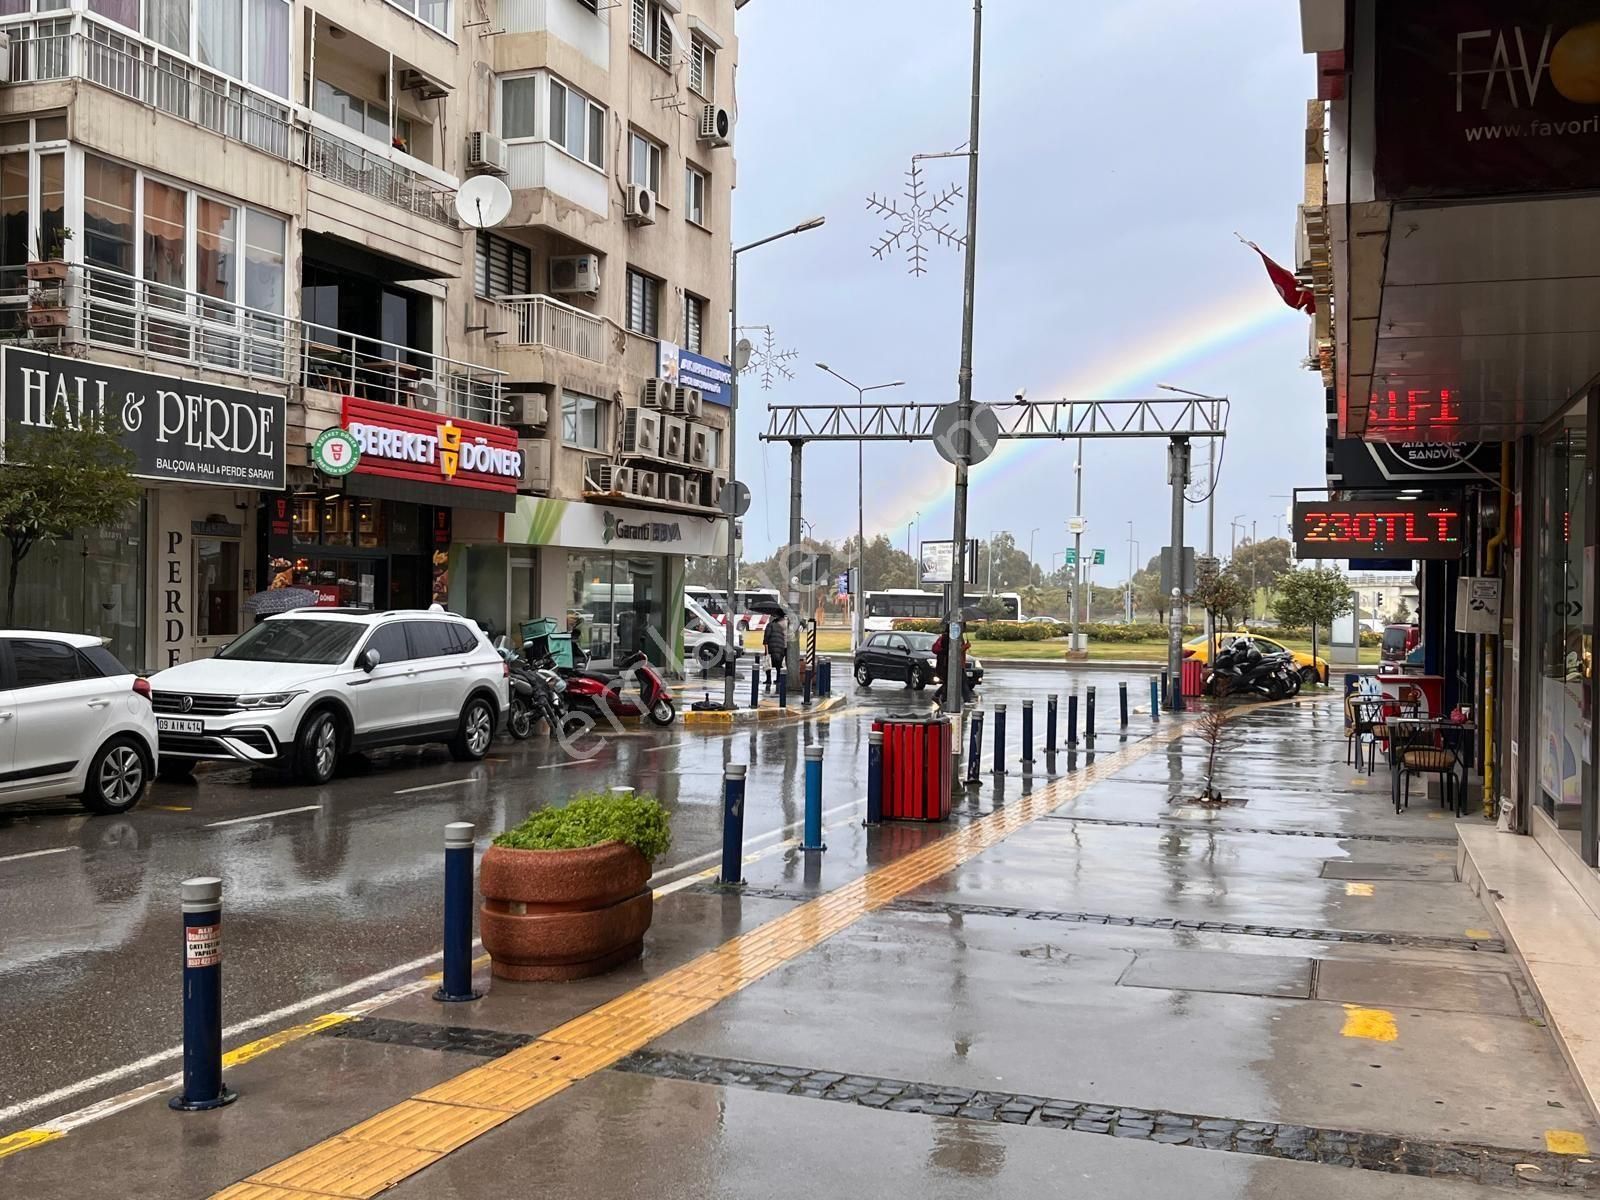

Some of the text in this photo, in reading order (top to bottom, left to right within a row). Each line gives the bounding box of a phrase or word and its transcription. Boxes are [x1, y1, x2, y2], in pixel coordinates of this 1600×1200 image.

[20, 367, 274, 460] HALI & PERDE
[348, 422, 522, 478] BEREKET DÖNER
[156, 458, 274, 480] BALÇOVA HALI & PERDE SARAYI
[616, 518, 650, 540] Garanti
[159, 720, 168, 729] 09
[187, 722, 200, 731] 414
